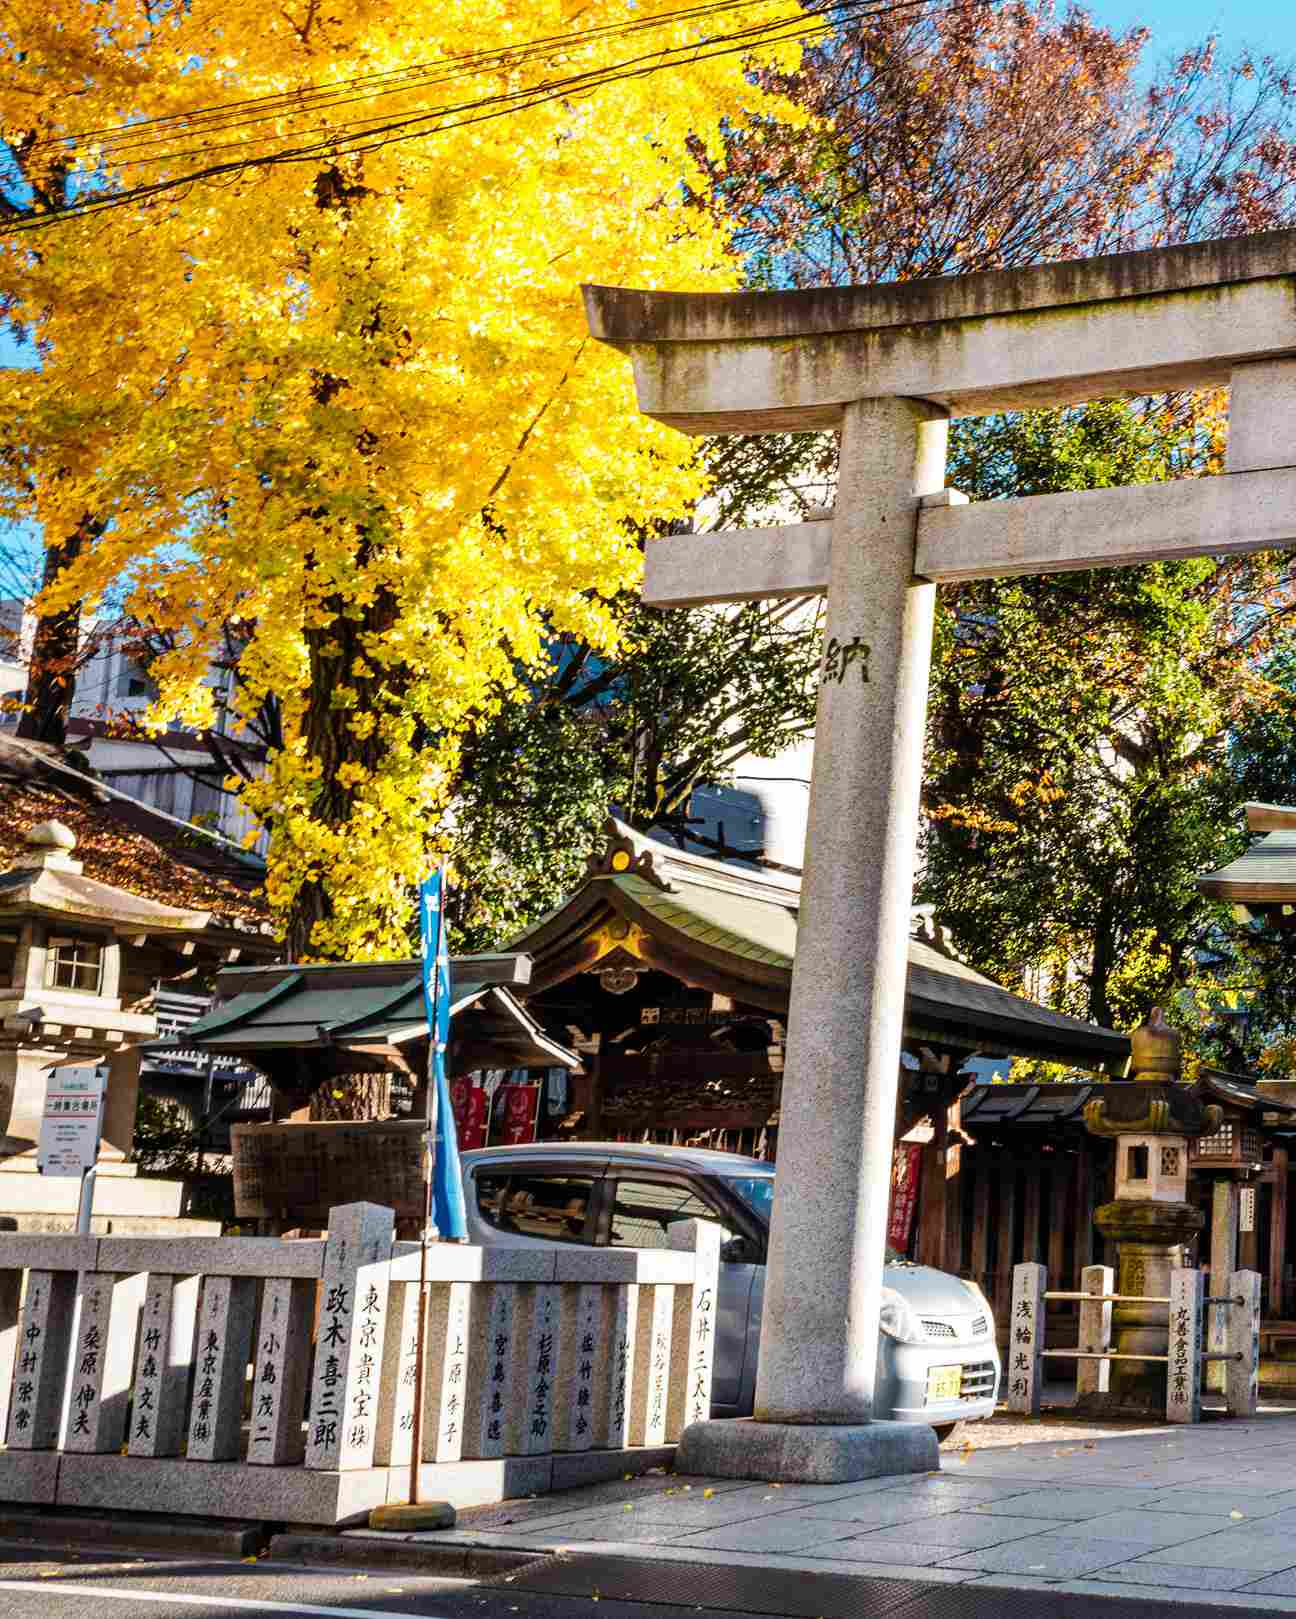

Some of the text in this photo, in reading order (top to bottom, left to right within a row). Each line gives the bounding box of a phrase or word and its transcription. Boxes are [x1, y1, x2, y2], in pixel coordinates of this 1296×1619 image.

[822, 635, 870, 686] 納
[314, 1284, 350, 1449] 政木喜三郎
